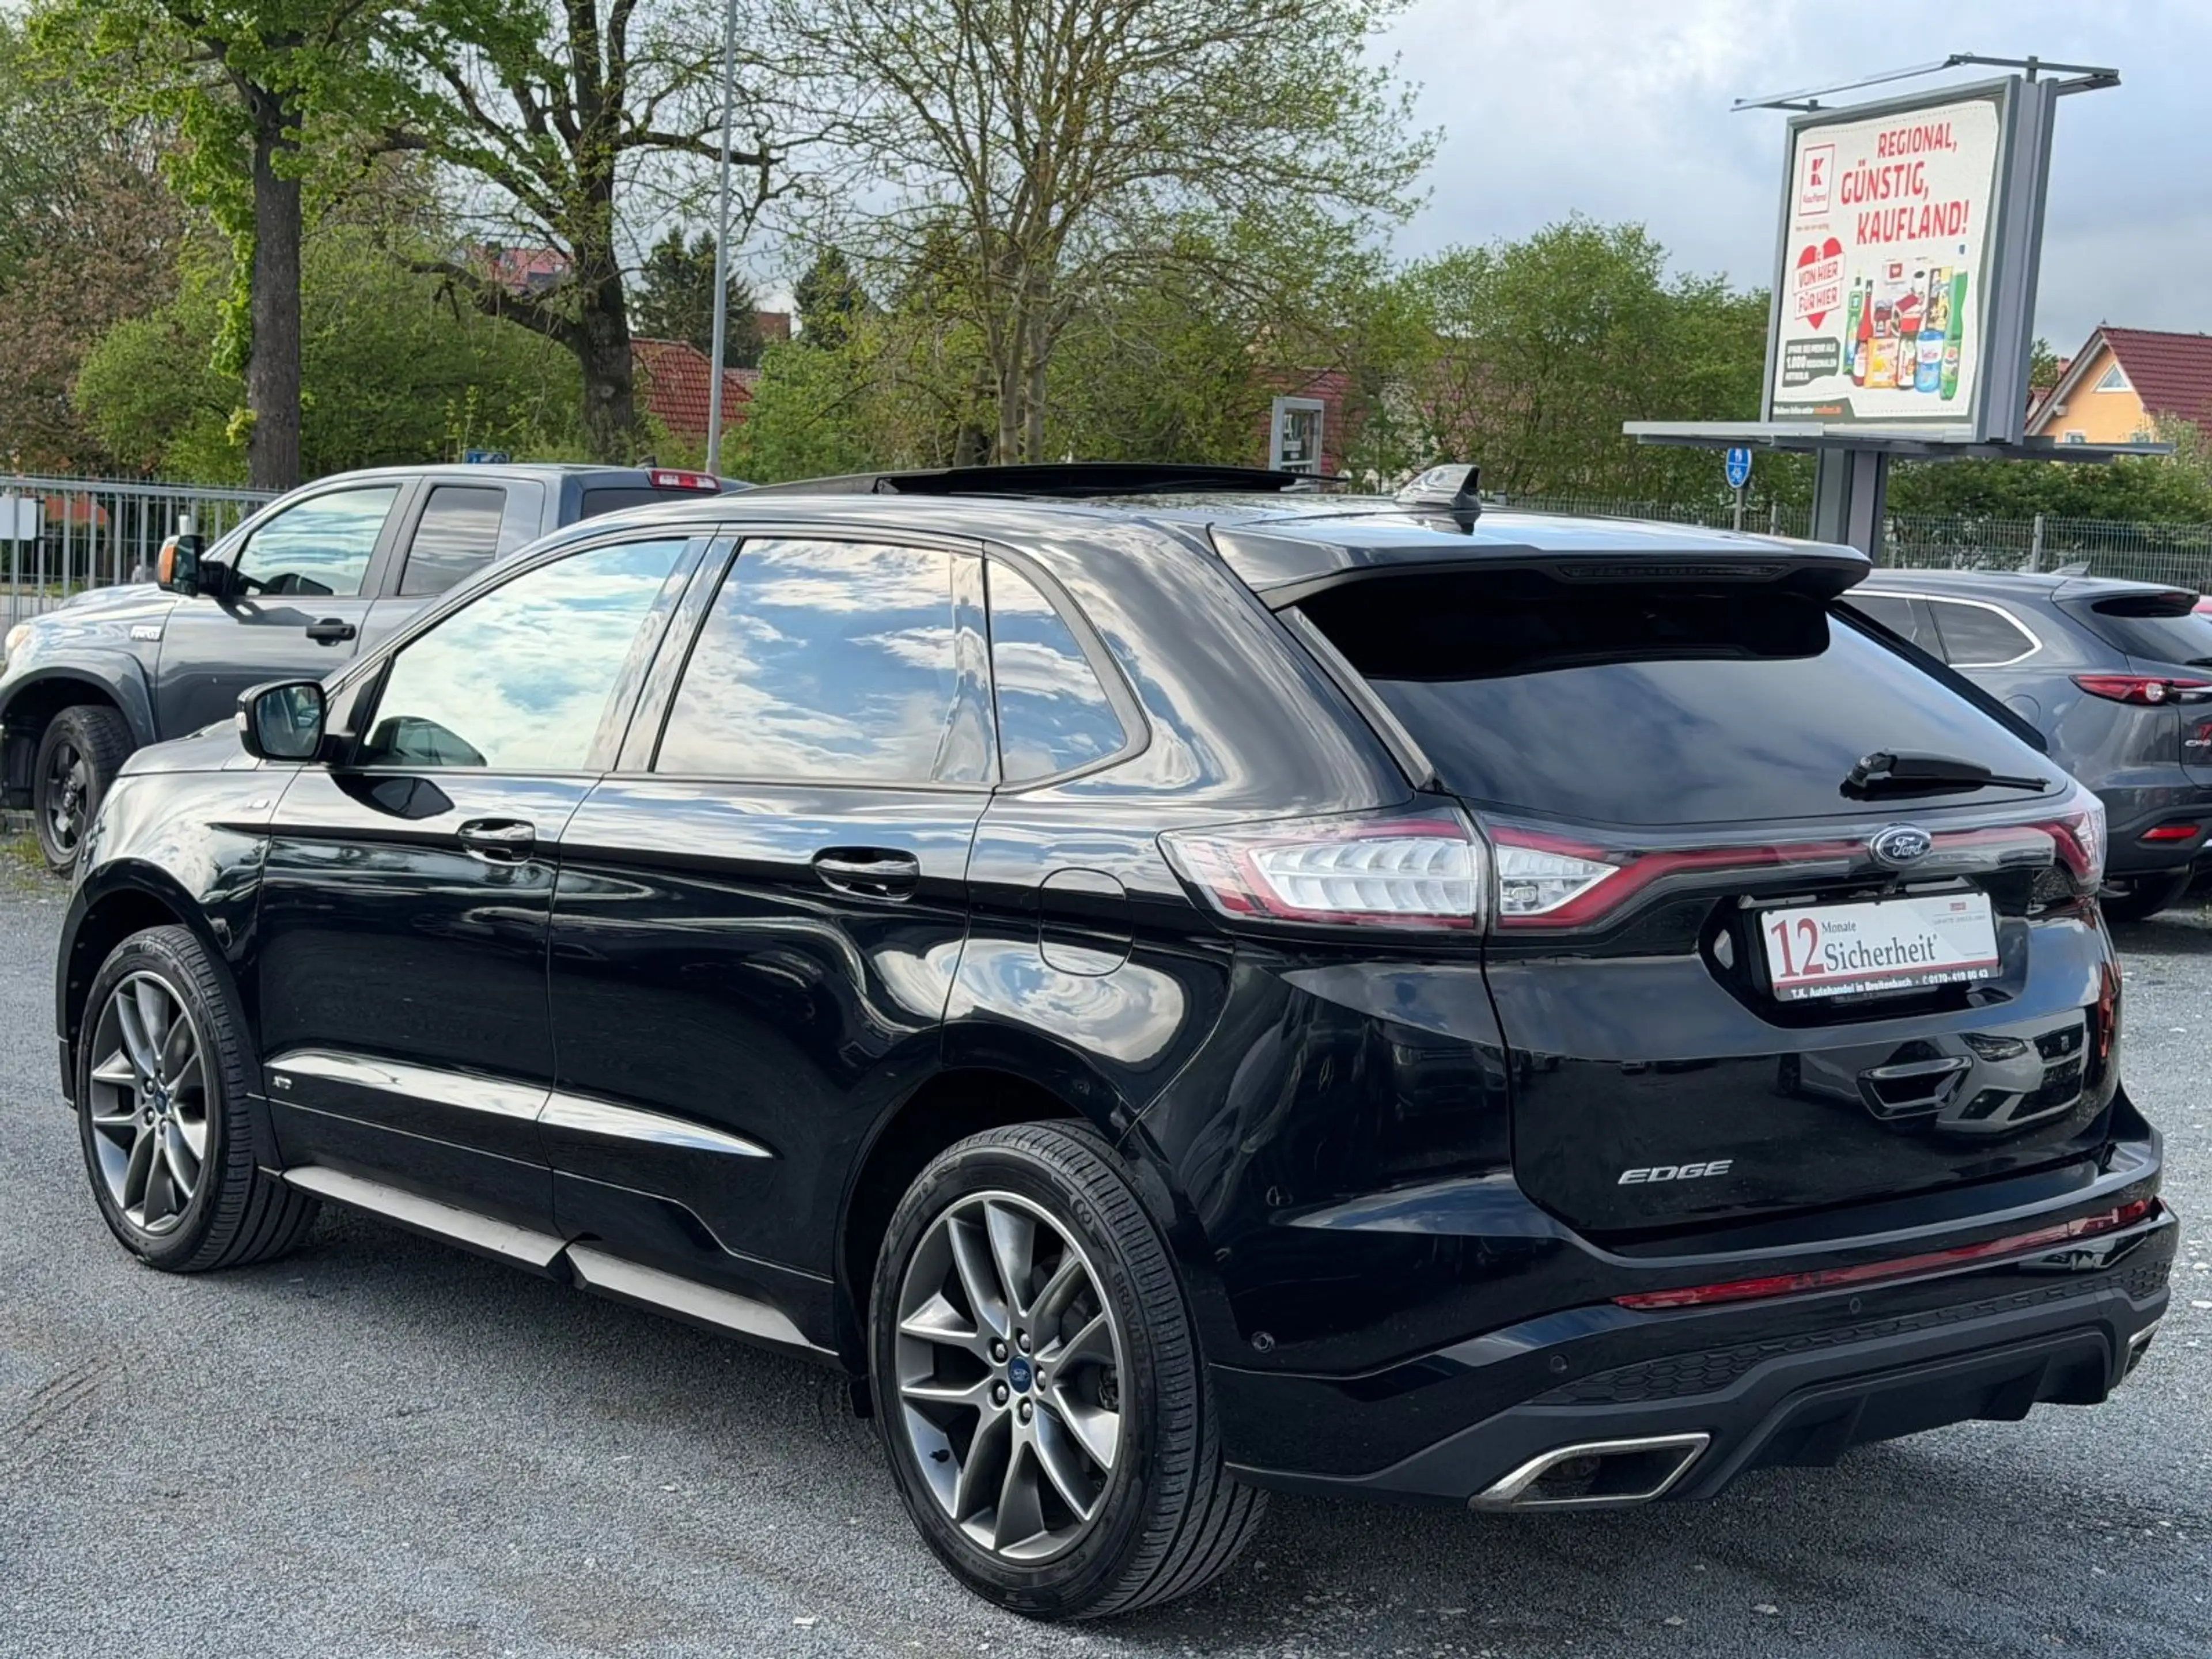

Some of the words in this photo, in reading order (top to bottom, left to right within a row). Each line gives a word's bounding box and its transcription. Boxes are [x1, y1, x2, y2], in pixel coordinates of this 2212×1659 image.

[1877, 122, 1957, 158] REGIONAL,
[1840, 159, 1929, 204] GÜNSTIG,
[1857, 199, 1970, 245] KAUFLAND!
[1798, 268, 1816, 288] VON
[1817, 260, 1838, 281] HIER
[1798, 290, 1815, 314] FÜR
[1816, 286, 1838, 308] HIER
[1892, 836, 1923, 857] Ford
[1821, 921, 1857, 934] Monate
[1771, 918, 1825, 978] 12
[1618, 1160, 1733, 1185] EDGE
